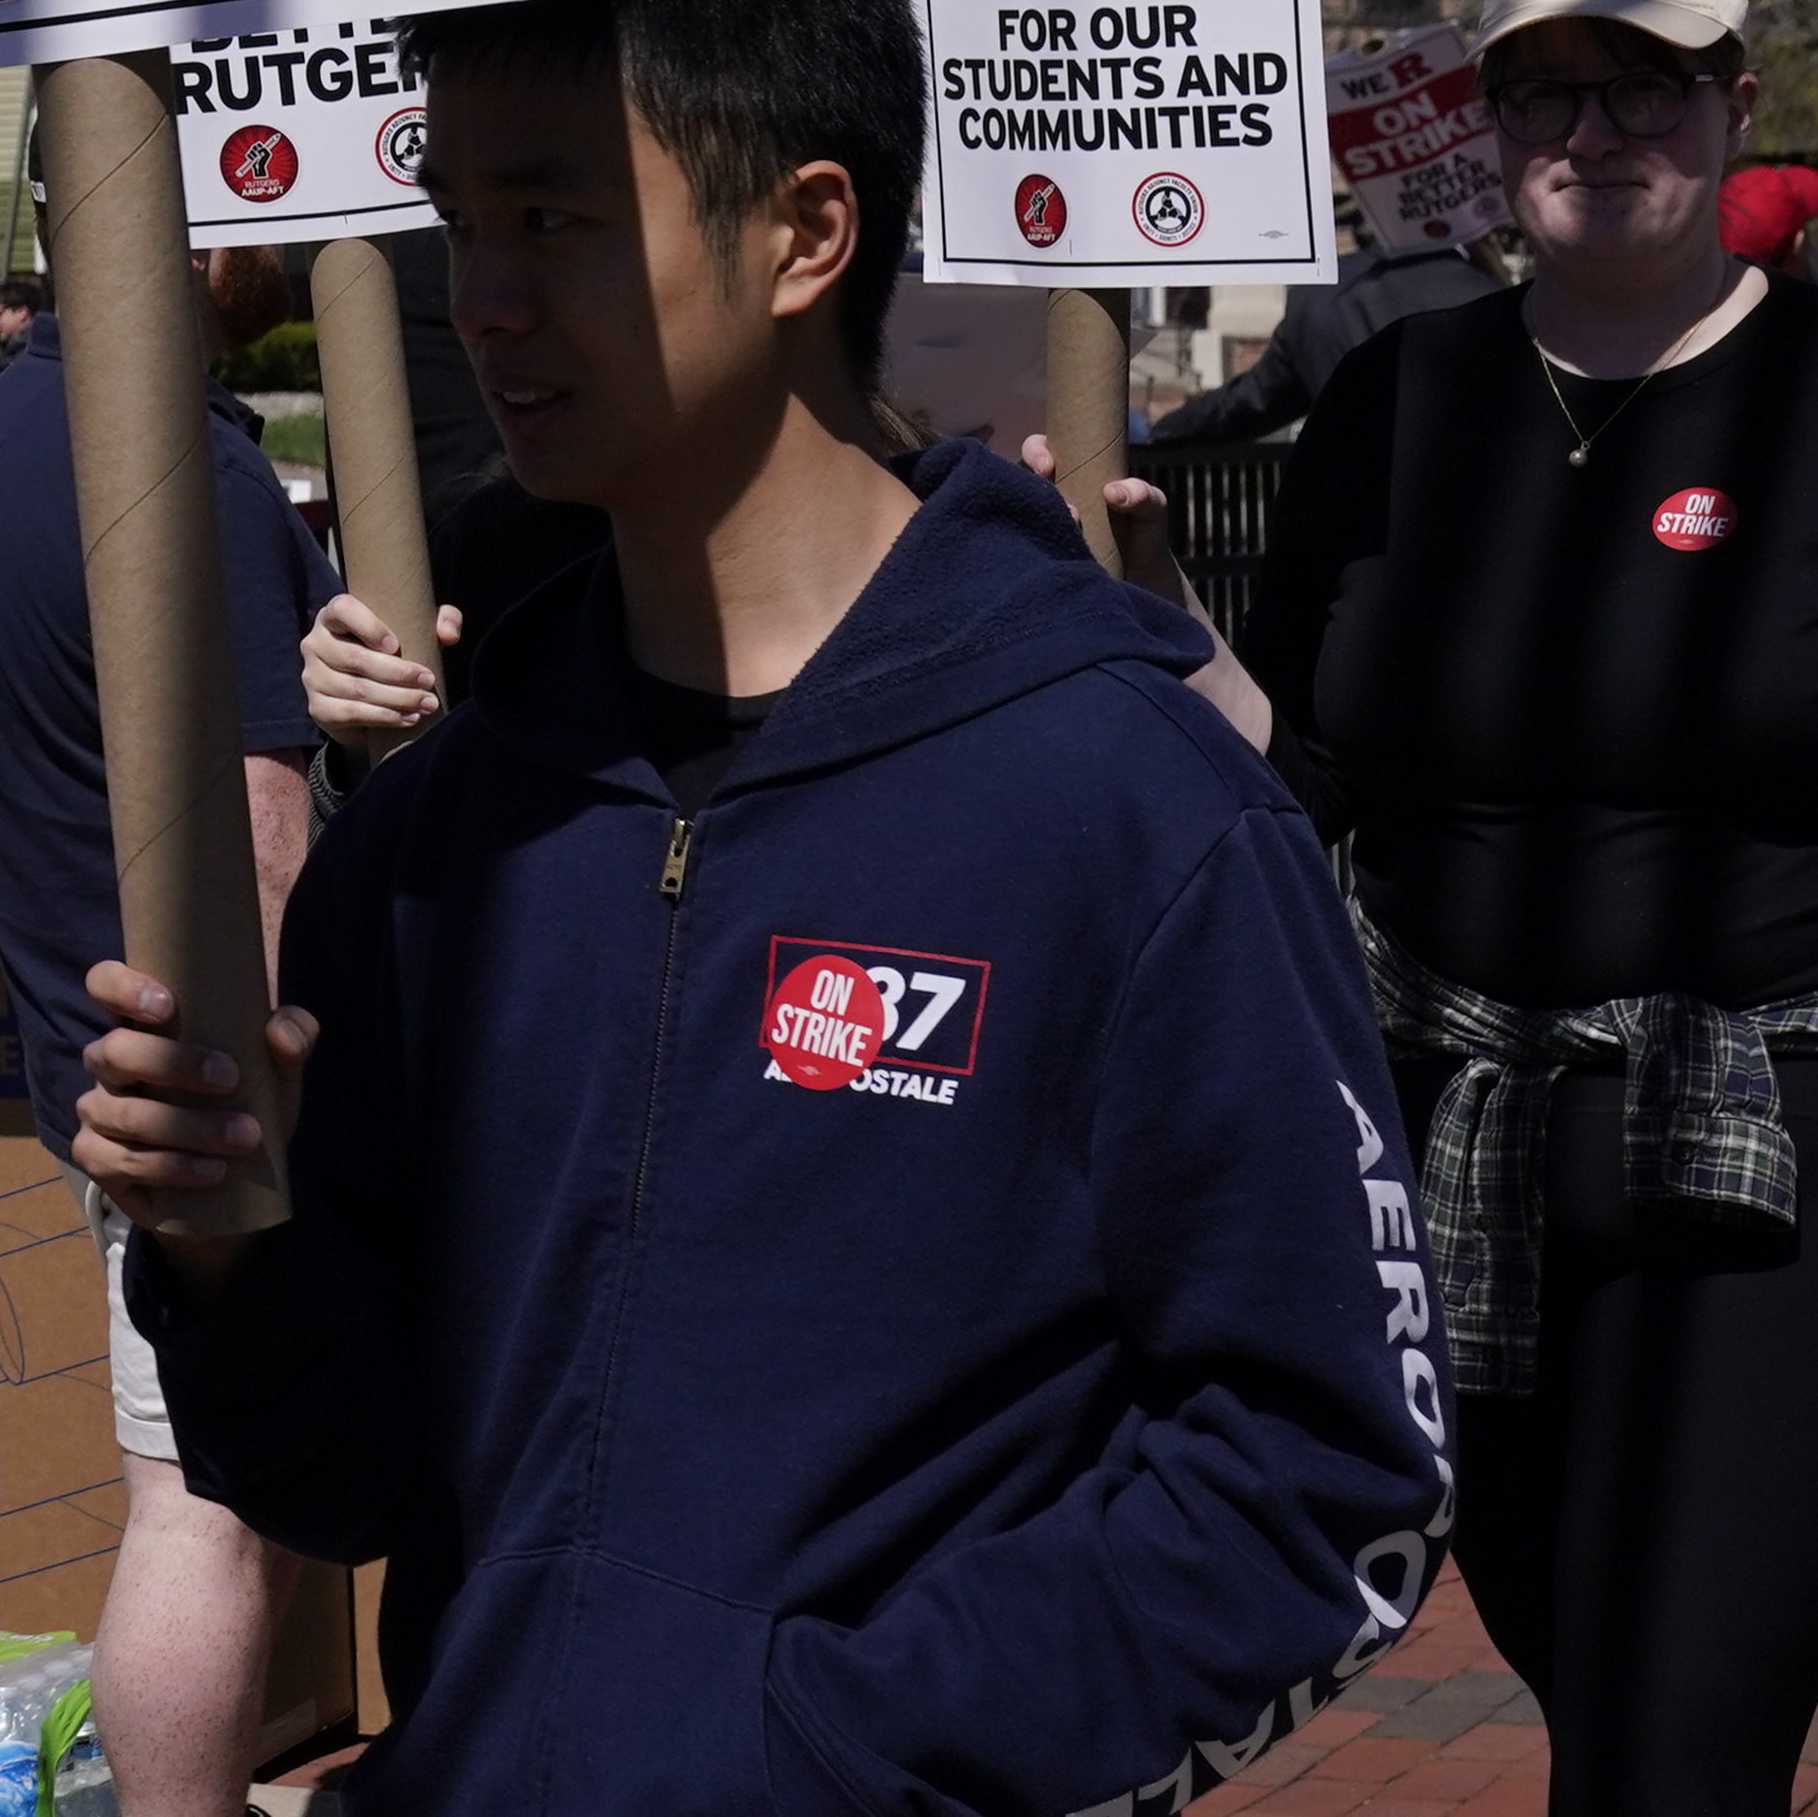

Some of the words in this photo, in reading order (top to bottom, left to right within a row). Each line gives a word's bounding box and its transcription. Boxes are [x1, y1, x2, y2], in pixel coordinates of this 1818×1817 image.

[998, 8, 1076, 51] FOR
[1090, 4, 1198, 50] OUR
[171, 41, 423, 115] RUTGE
[942, 56, 1165, 101] STUDENTS
[1176, 52, 1288, 97] AND
[1340, 71, 1390, 99] WE
[1388, 52, 1434, 88] R
[959, 103, 1273, 151] COMMUNITIES
[1344, 98, 1491, 176] STRIKE
[1372, 90, 1439, 137] ON
[241, 184, 284, 197] AAUP-AFT
[1657, 512, 1729, 537] STRIKE
[1685, 493, 1715, 515] ON
[810, 969, 855, 1016] ON
[771, 1003, 873, 1067] STRIKE
[764, 1058, 959, 1105] AOSTALE
